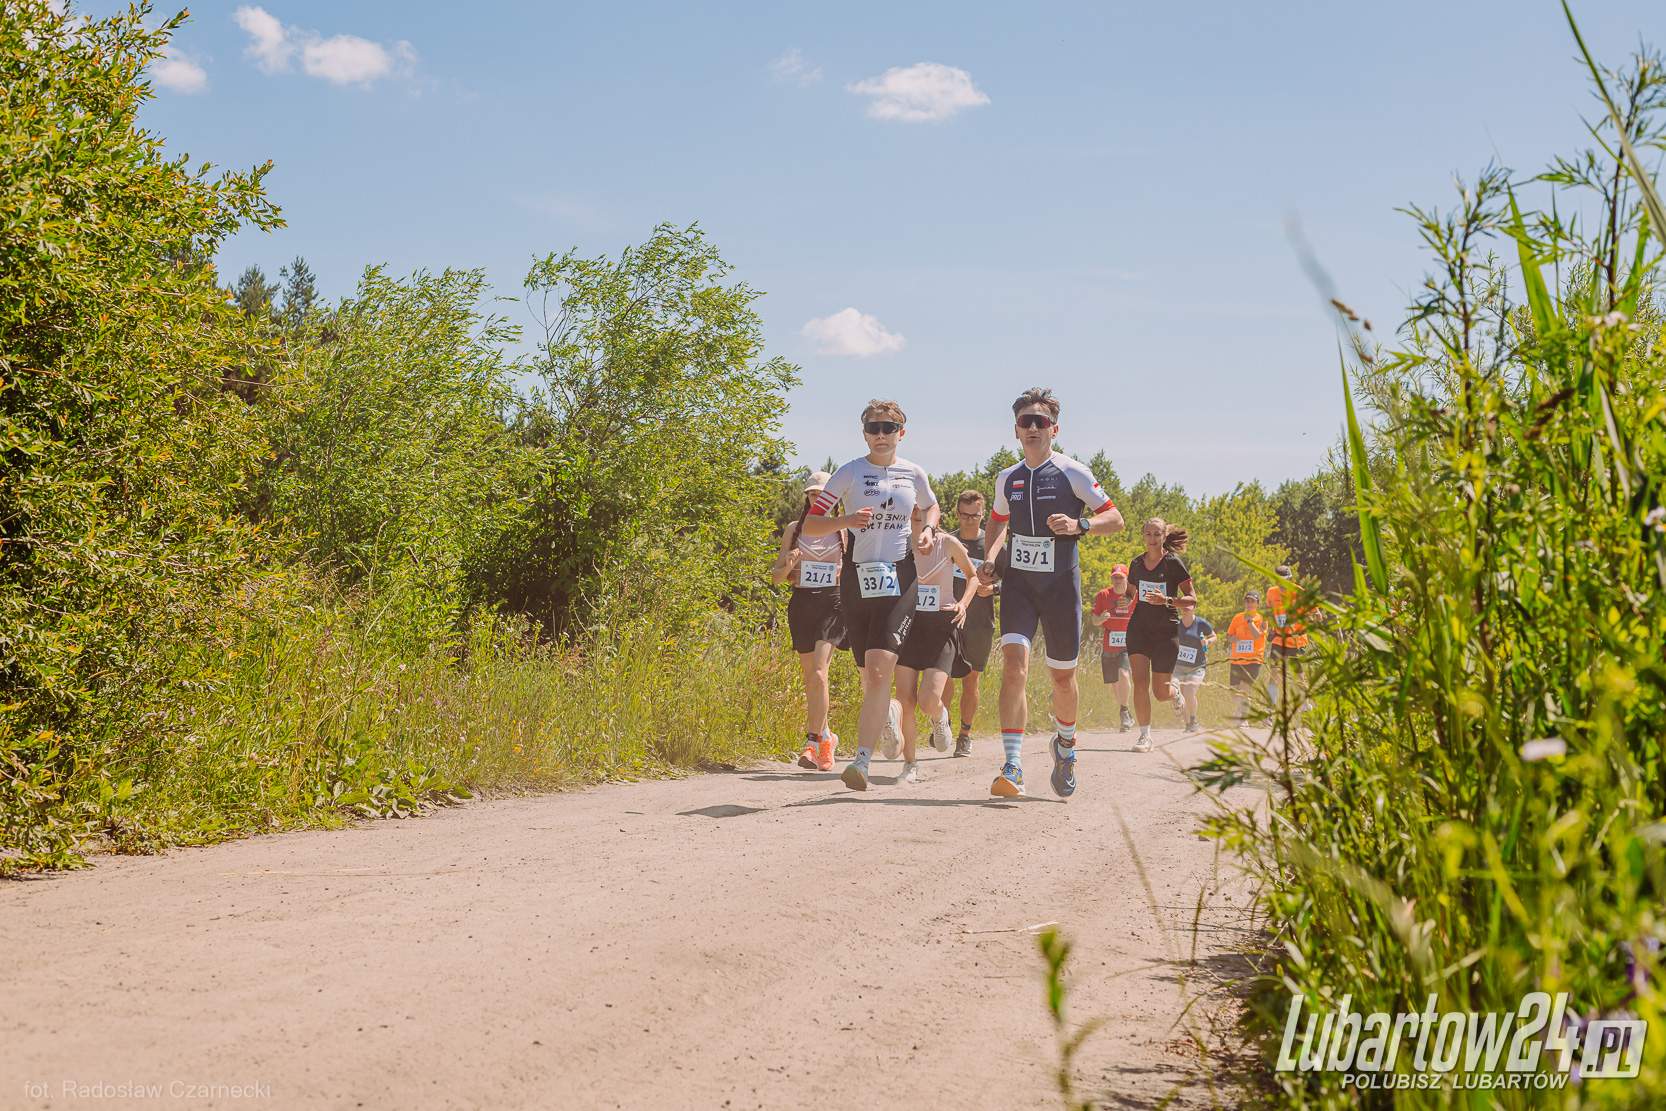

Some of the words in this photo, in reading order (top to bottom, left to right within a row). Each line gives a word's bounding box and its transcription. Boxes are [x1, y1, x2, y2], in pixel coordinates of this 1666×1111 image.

[1015, 549, 1048, 565] 33/1
[805, 571, 832, 583] 21/1
[863, 576, 895, 590] 33/2
